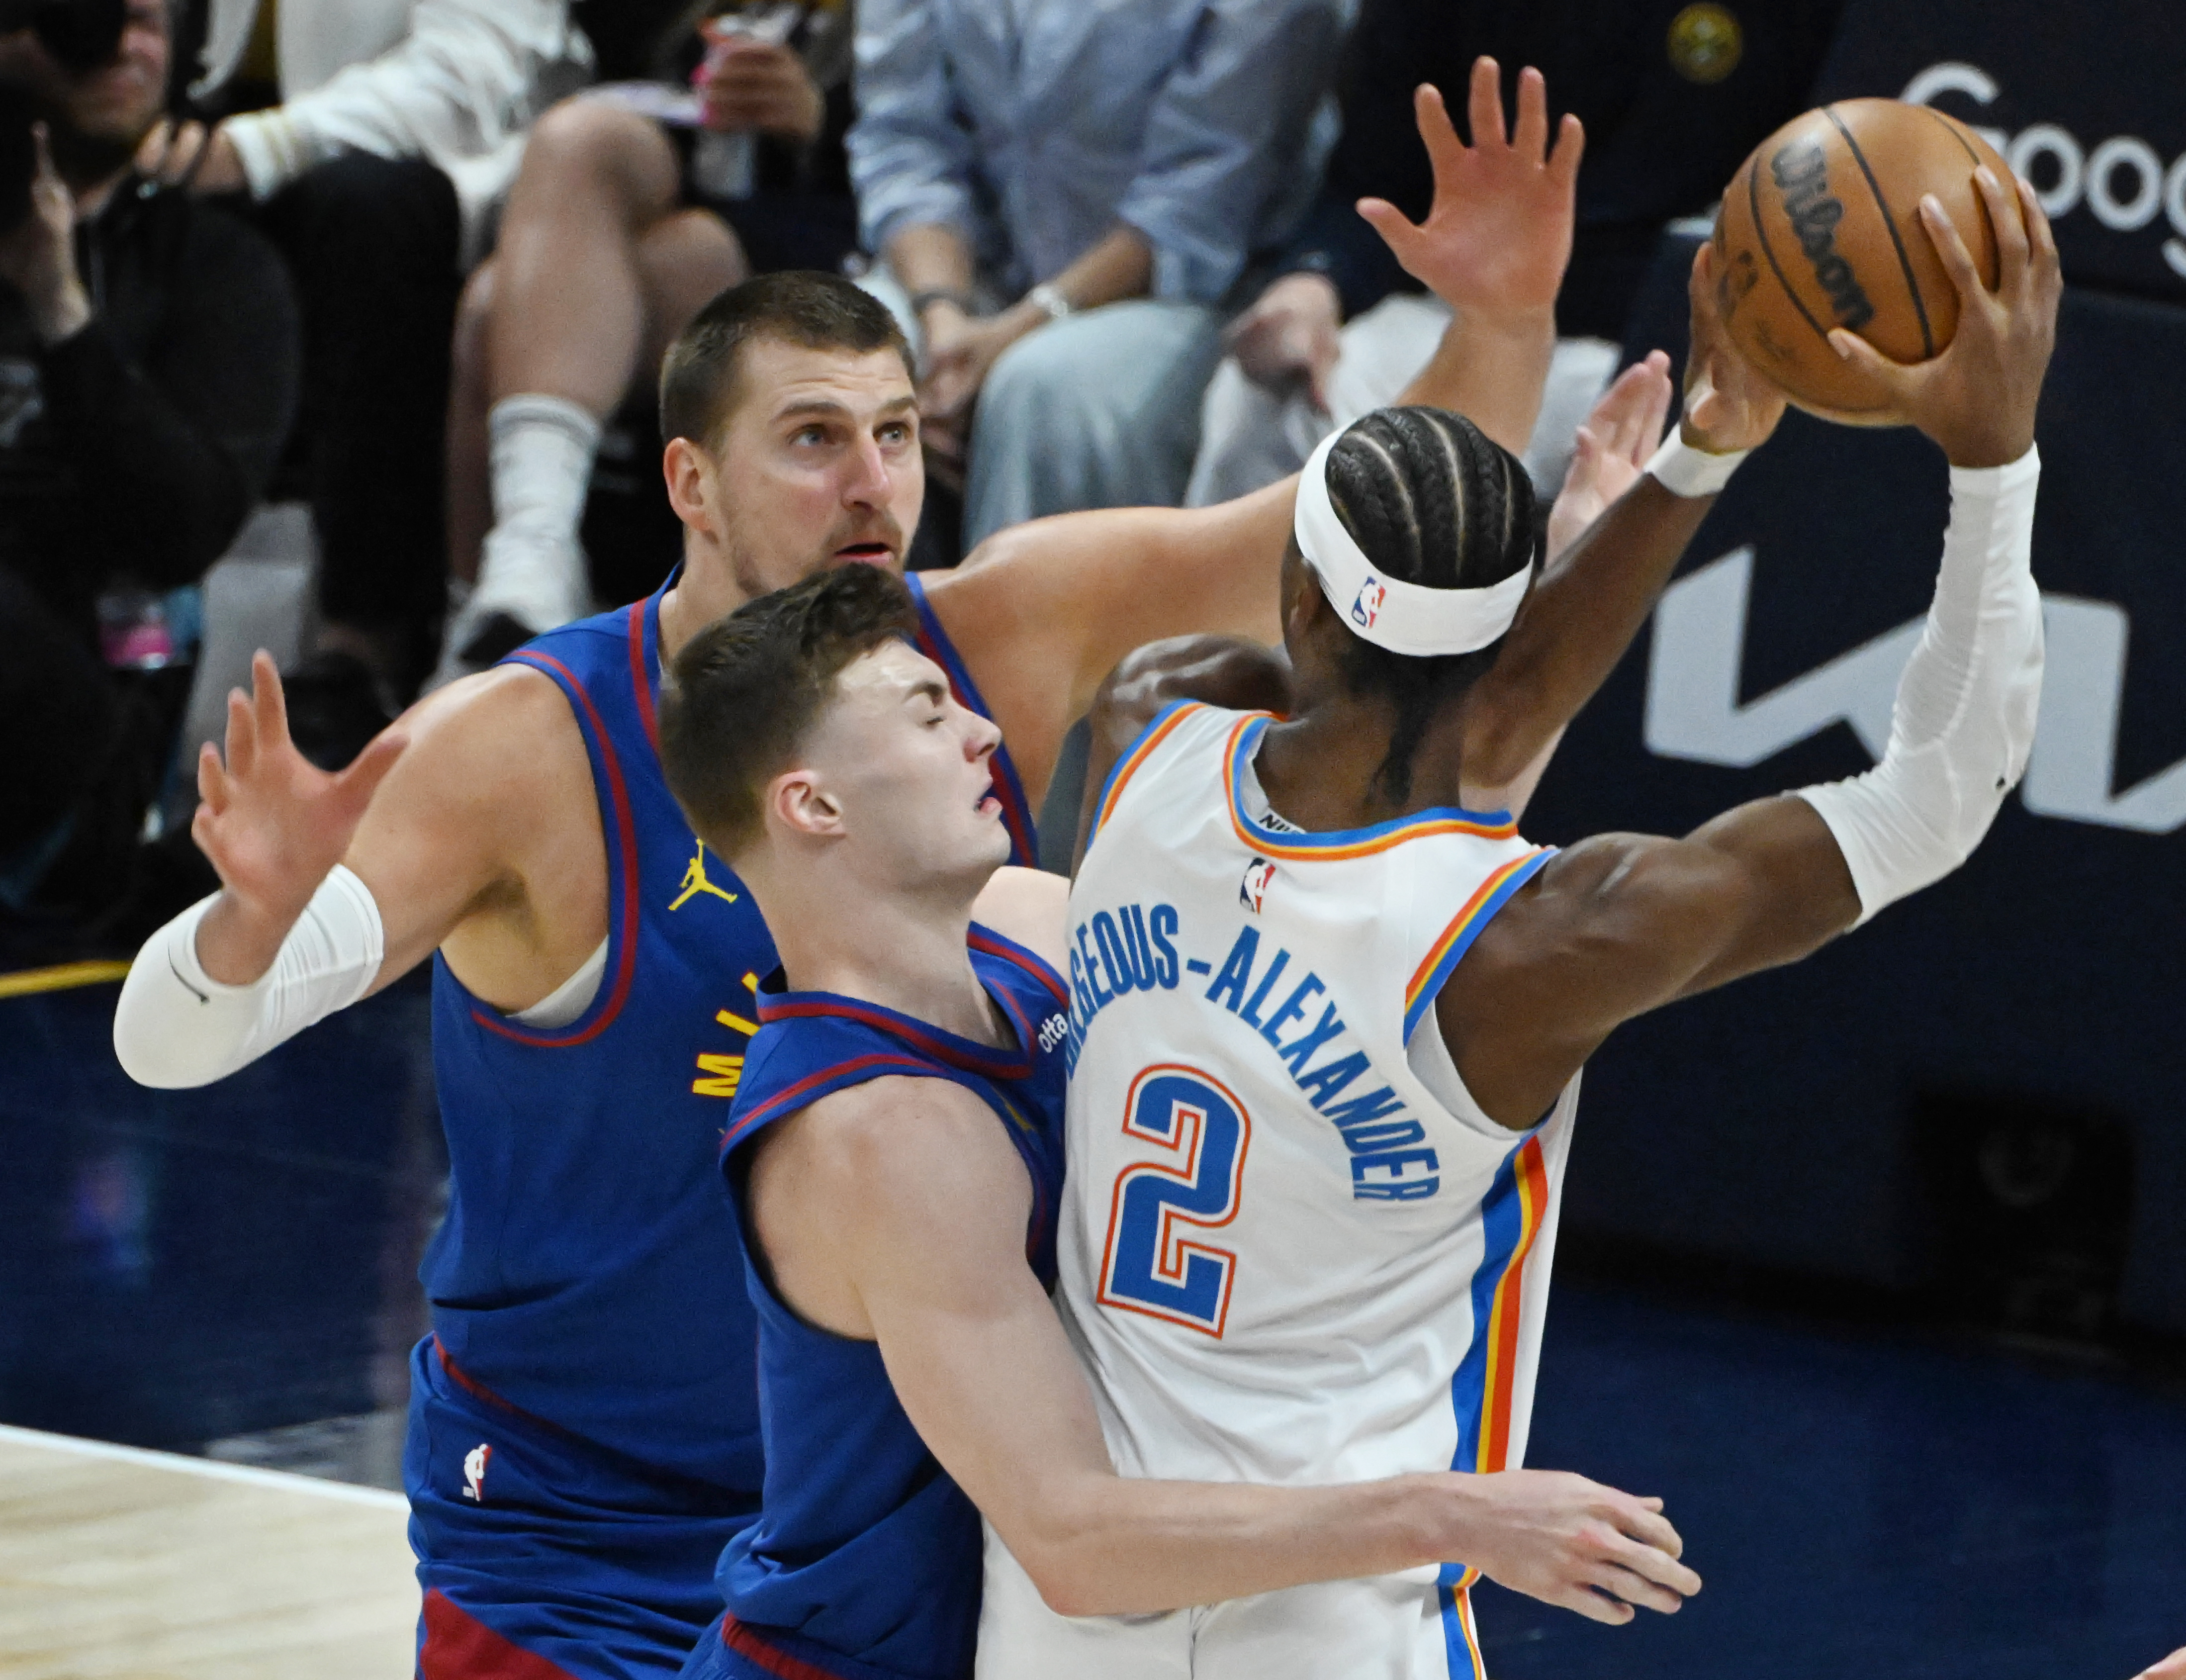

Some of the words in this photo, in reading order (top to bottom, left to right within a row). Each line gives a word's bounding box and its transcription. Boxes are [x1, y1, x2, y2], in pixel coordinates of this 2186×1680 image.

[1038, 1013, 1068, 1053] otta
[1066, 904, 1440, 1201] GEOUS-ALEXANDER
[1096, 1063, 1251, 1340] 2
